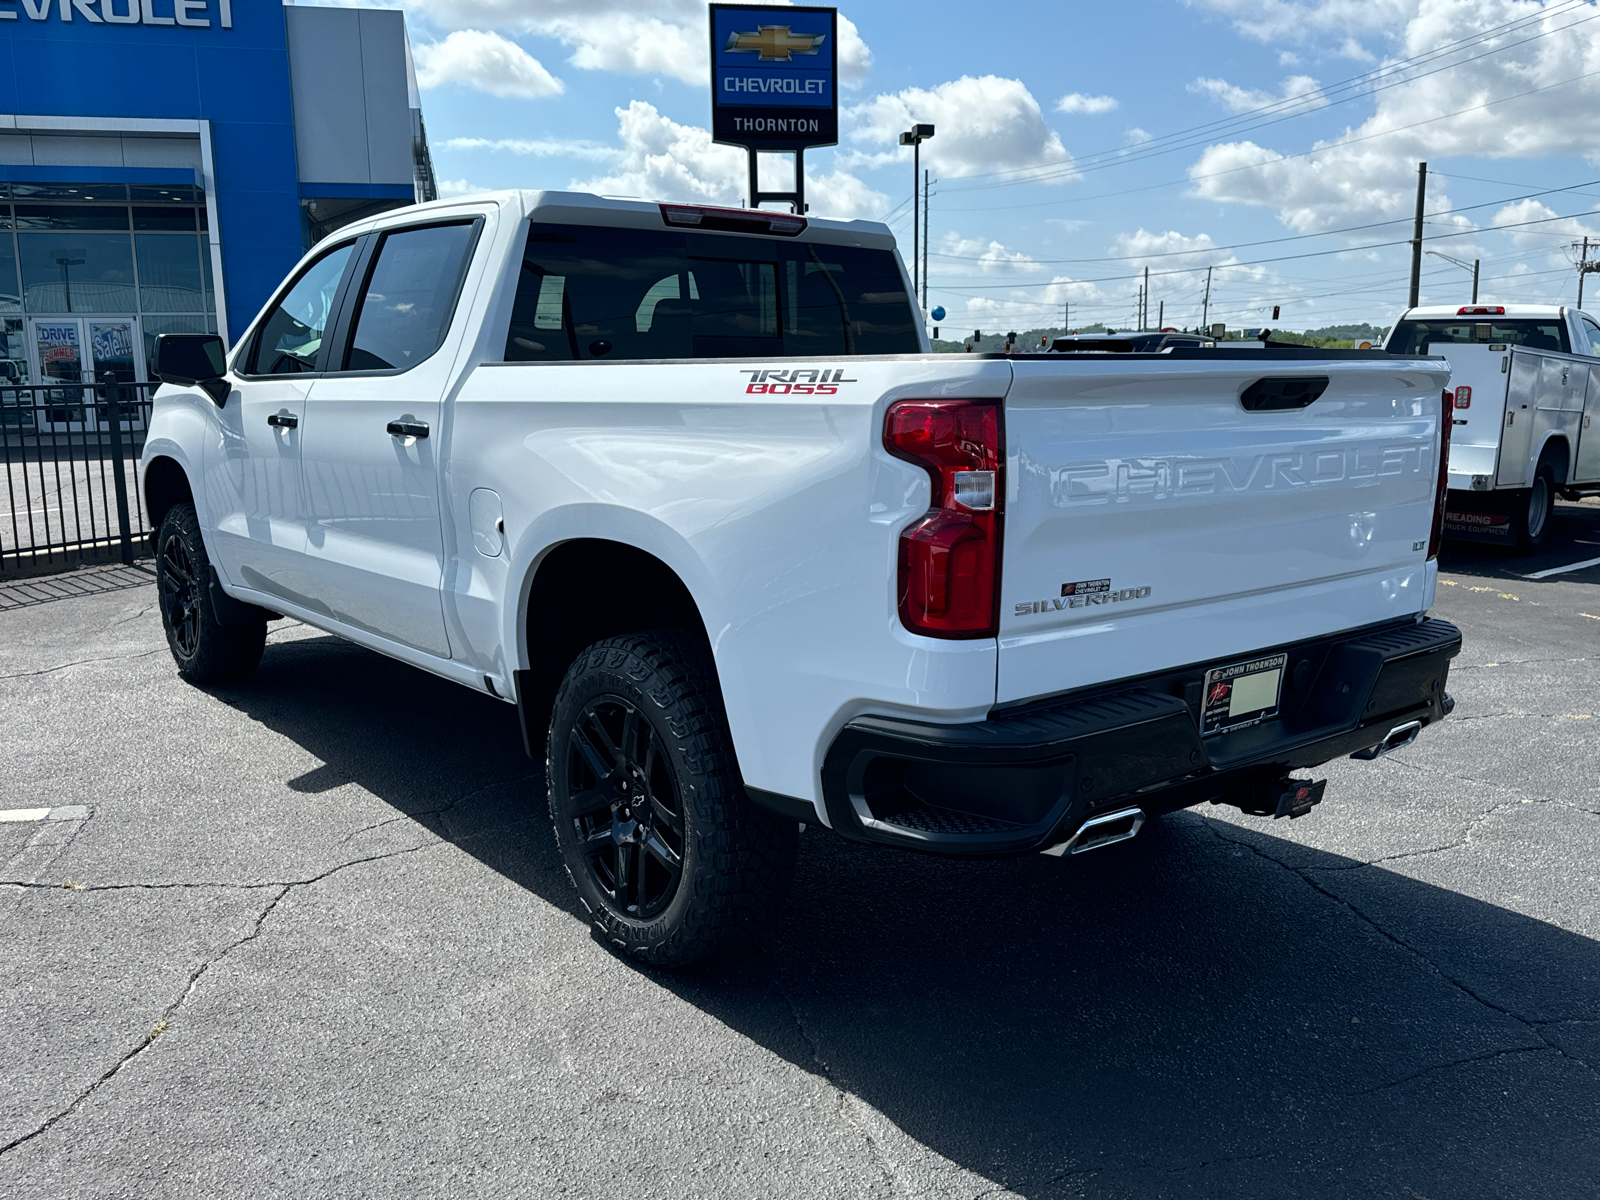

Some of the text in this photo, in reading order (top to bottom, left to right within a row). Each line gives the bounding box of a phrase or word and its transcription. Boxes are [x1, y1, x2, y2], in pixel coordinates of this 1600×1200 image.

[723, 77, 826, 94] CHEVROLET
[734, 117, 819, 133] THORNTON
[41, 328, 76, 341] DRIVE
[45, 347, 76, 362] SUMMER
[740, 369, 858, 382] TRAIL
[746, 383, 839, 395] BOSS
[1053, 442, 1431, 507] CHEVROLET
[1446, 512, 1491, 525] READING
[1444, 523, 1509, 536] TRUCK EQUIPMENT
[1088, 579, 1110, 588] THORNTON
[1074, 586, 1102, 595] CHEVROLET
[1014, 585, 1152, 616] SILVERADO
[1225, 656, 1284, 676] JOHN THORNTON
